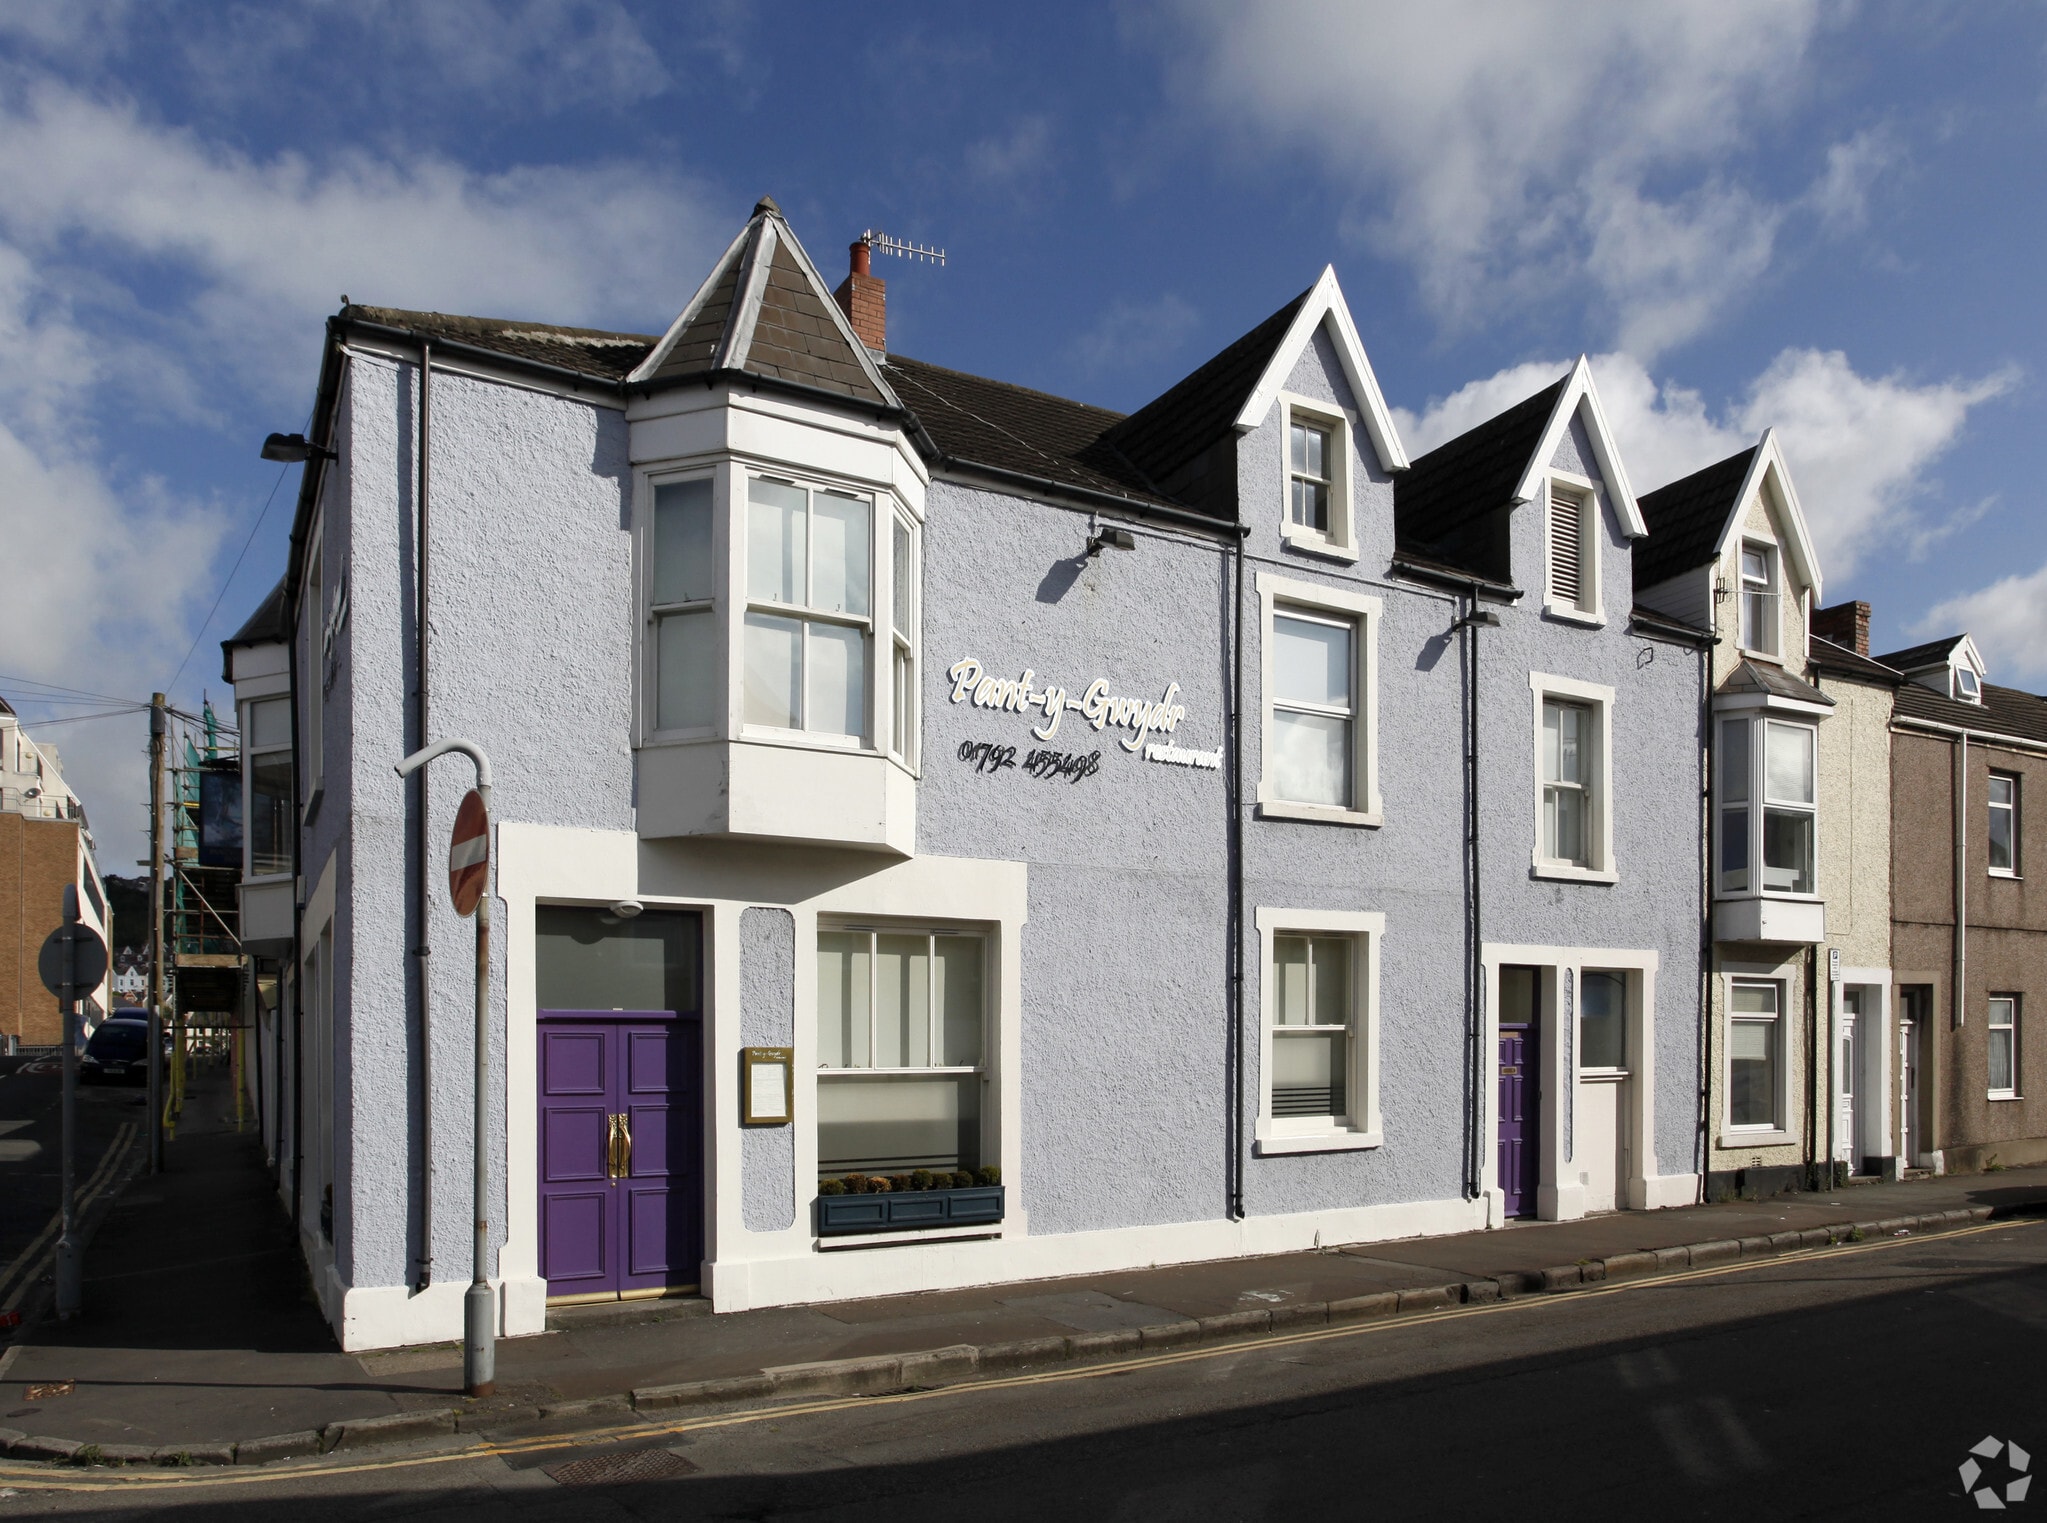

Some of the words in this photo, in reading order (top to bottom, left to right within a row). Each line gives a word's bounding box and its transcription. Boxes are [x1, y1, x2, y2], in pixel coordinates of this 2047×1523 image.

[949, 657, 1185, 751] Pant-y-Gwydr
[957, 740, 1016, 774] 01792
[1021, 748, 1101, 784] 455498
[1145, 739, 1223, 768] restaurant
